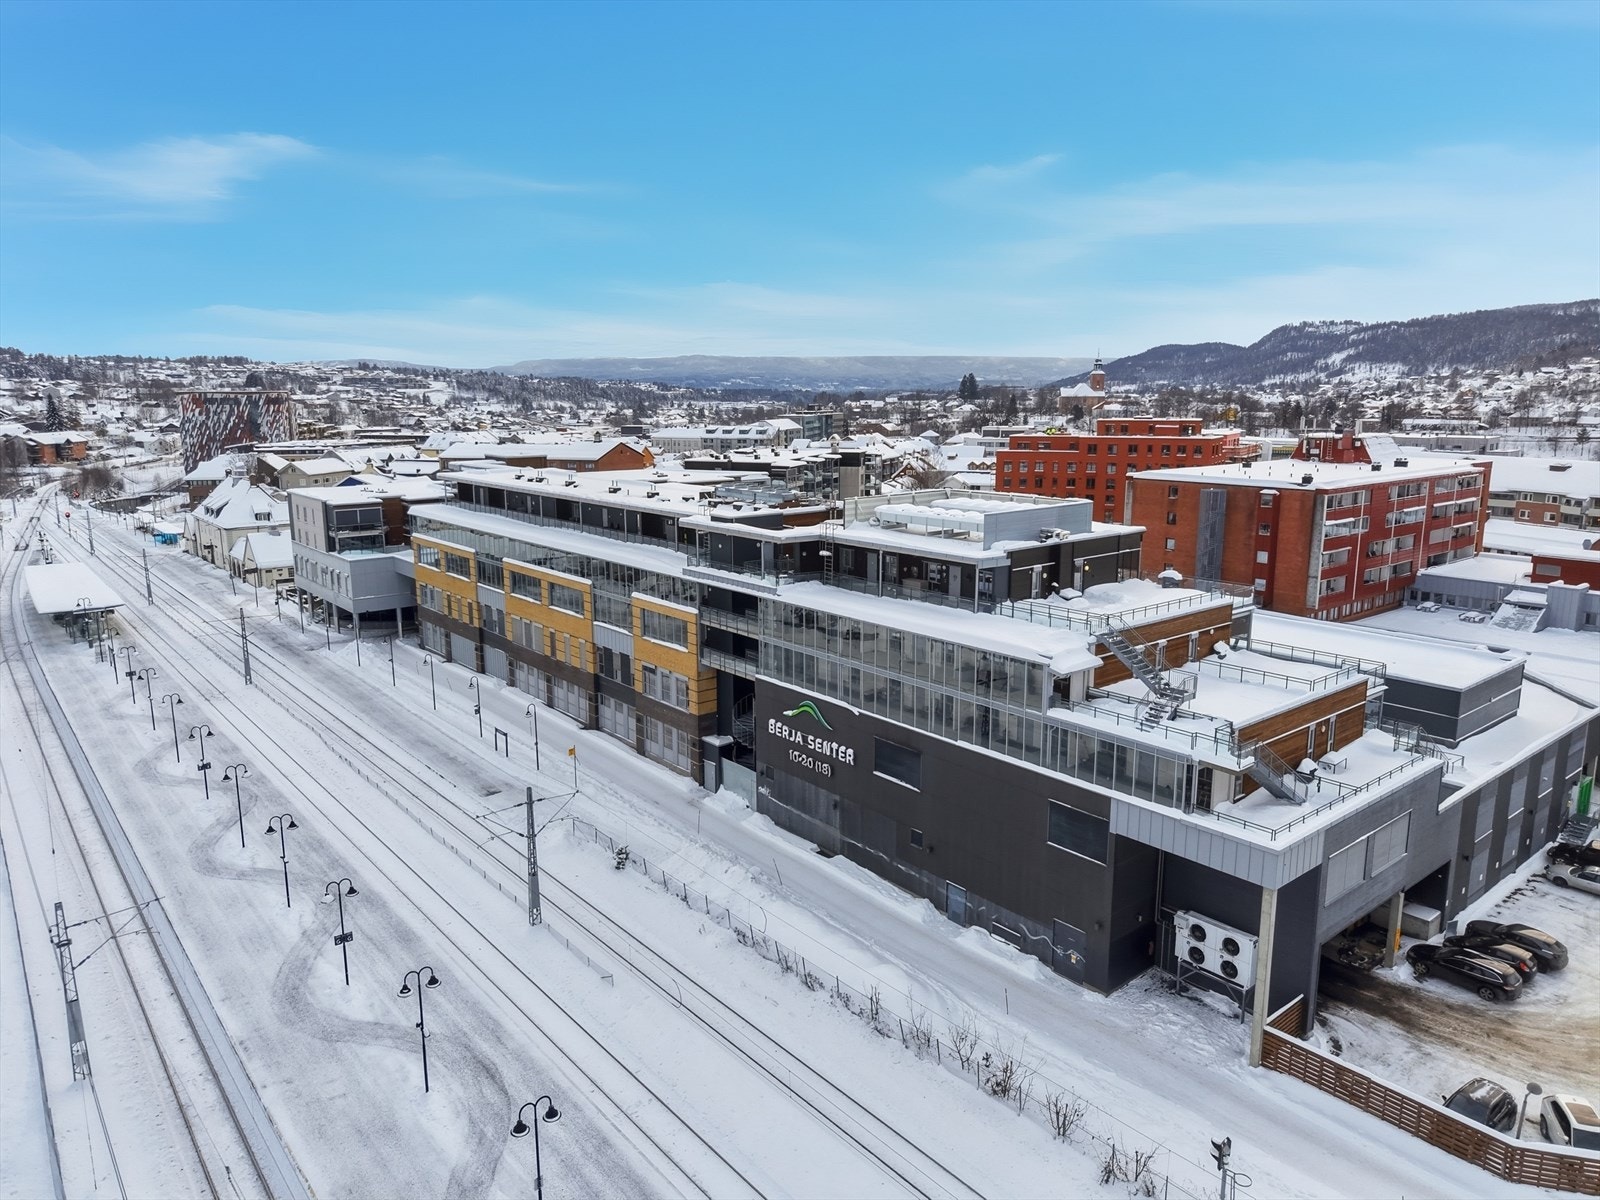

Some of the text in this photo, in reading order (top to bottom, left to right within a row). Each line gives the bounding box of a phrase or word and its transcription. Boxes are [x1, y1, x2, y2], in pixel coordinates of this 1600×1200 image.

[768, 718, 855, 766] BERJA SENTER
[815, 760, 832, 778] (18)
